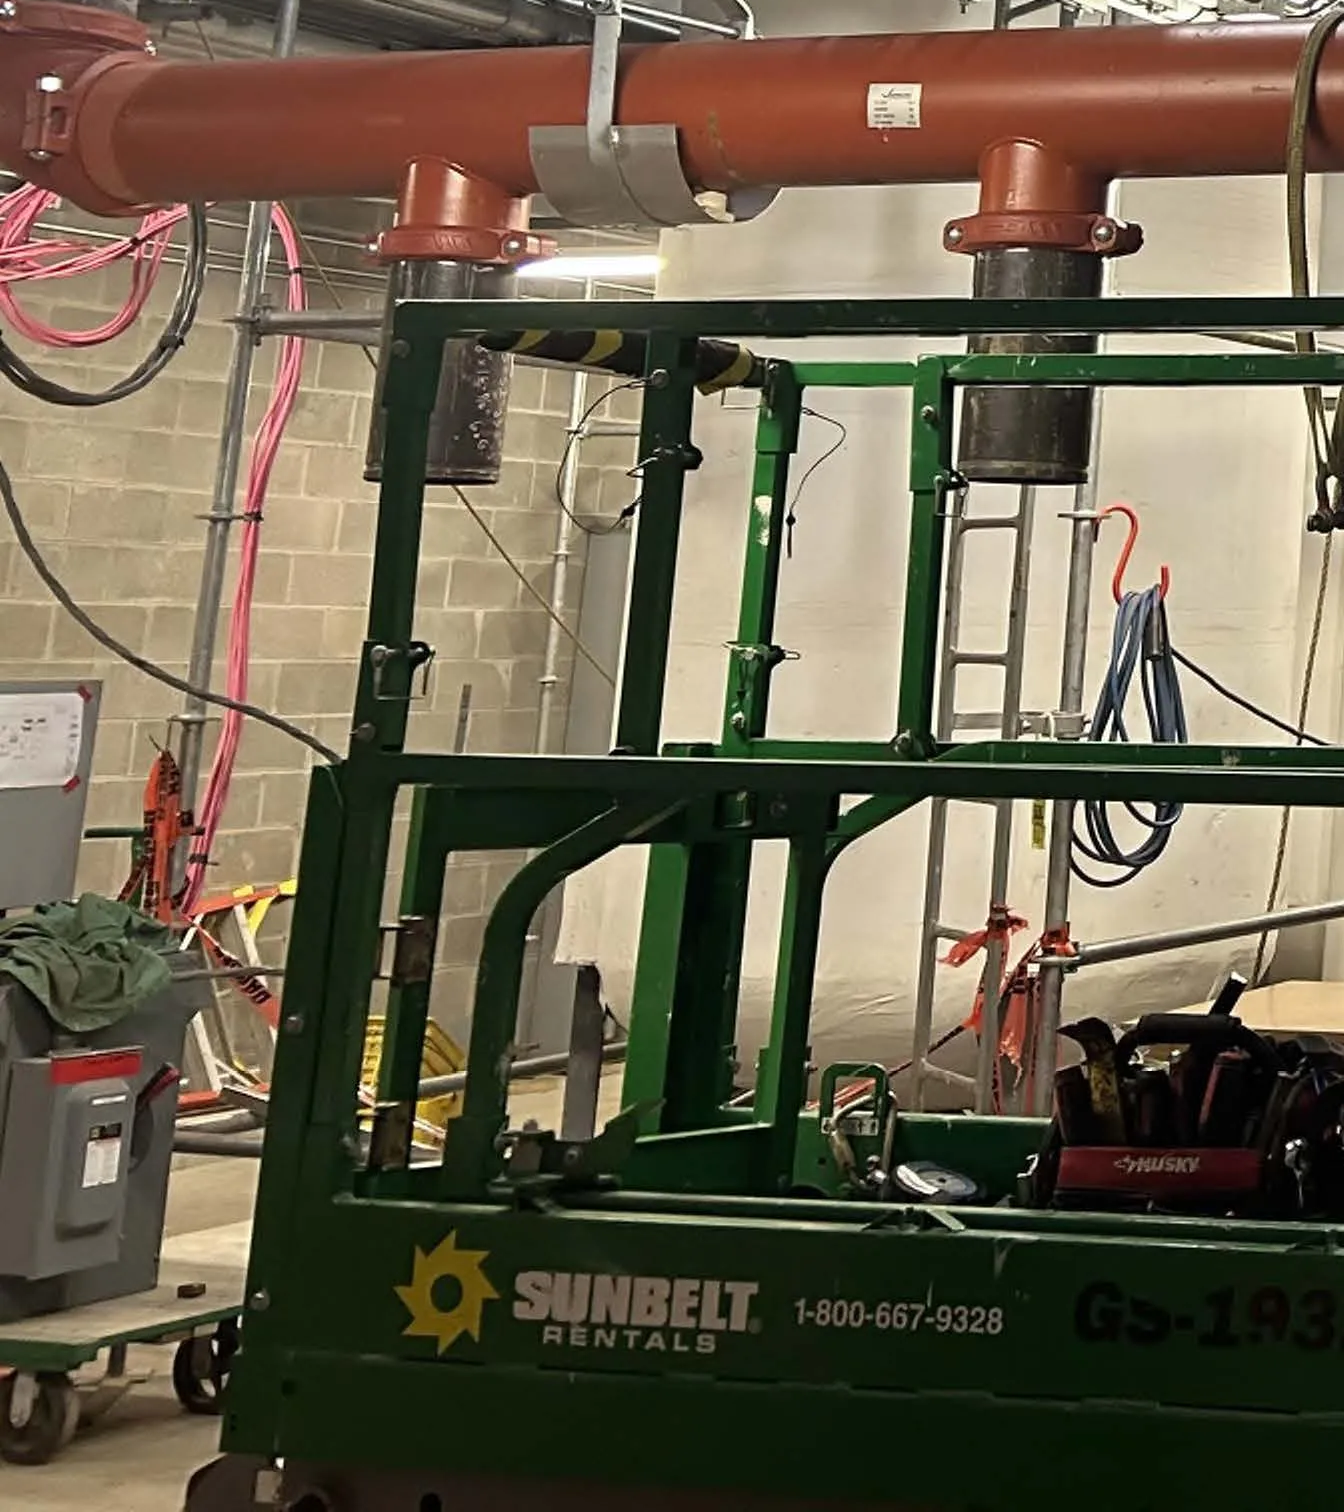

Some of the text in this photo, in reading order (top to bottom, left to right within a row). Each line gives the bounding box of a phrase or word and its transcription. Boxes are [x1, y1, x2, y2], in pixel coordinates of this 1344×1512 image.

[1133, 1155, 1200, 1173] HUSKY
[513, 1271, 759, 1332] SUNBELT
[795, 1297, 1003, 1335] 1-800-667-9328
[542, 1325, 717, 1354] RENTALS
